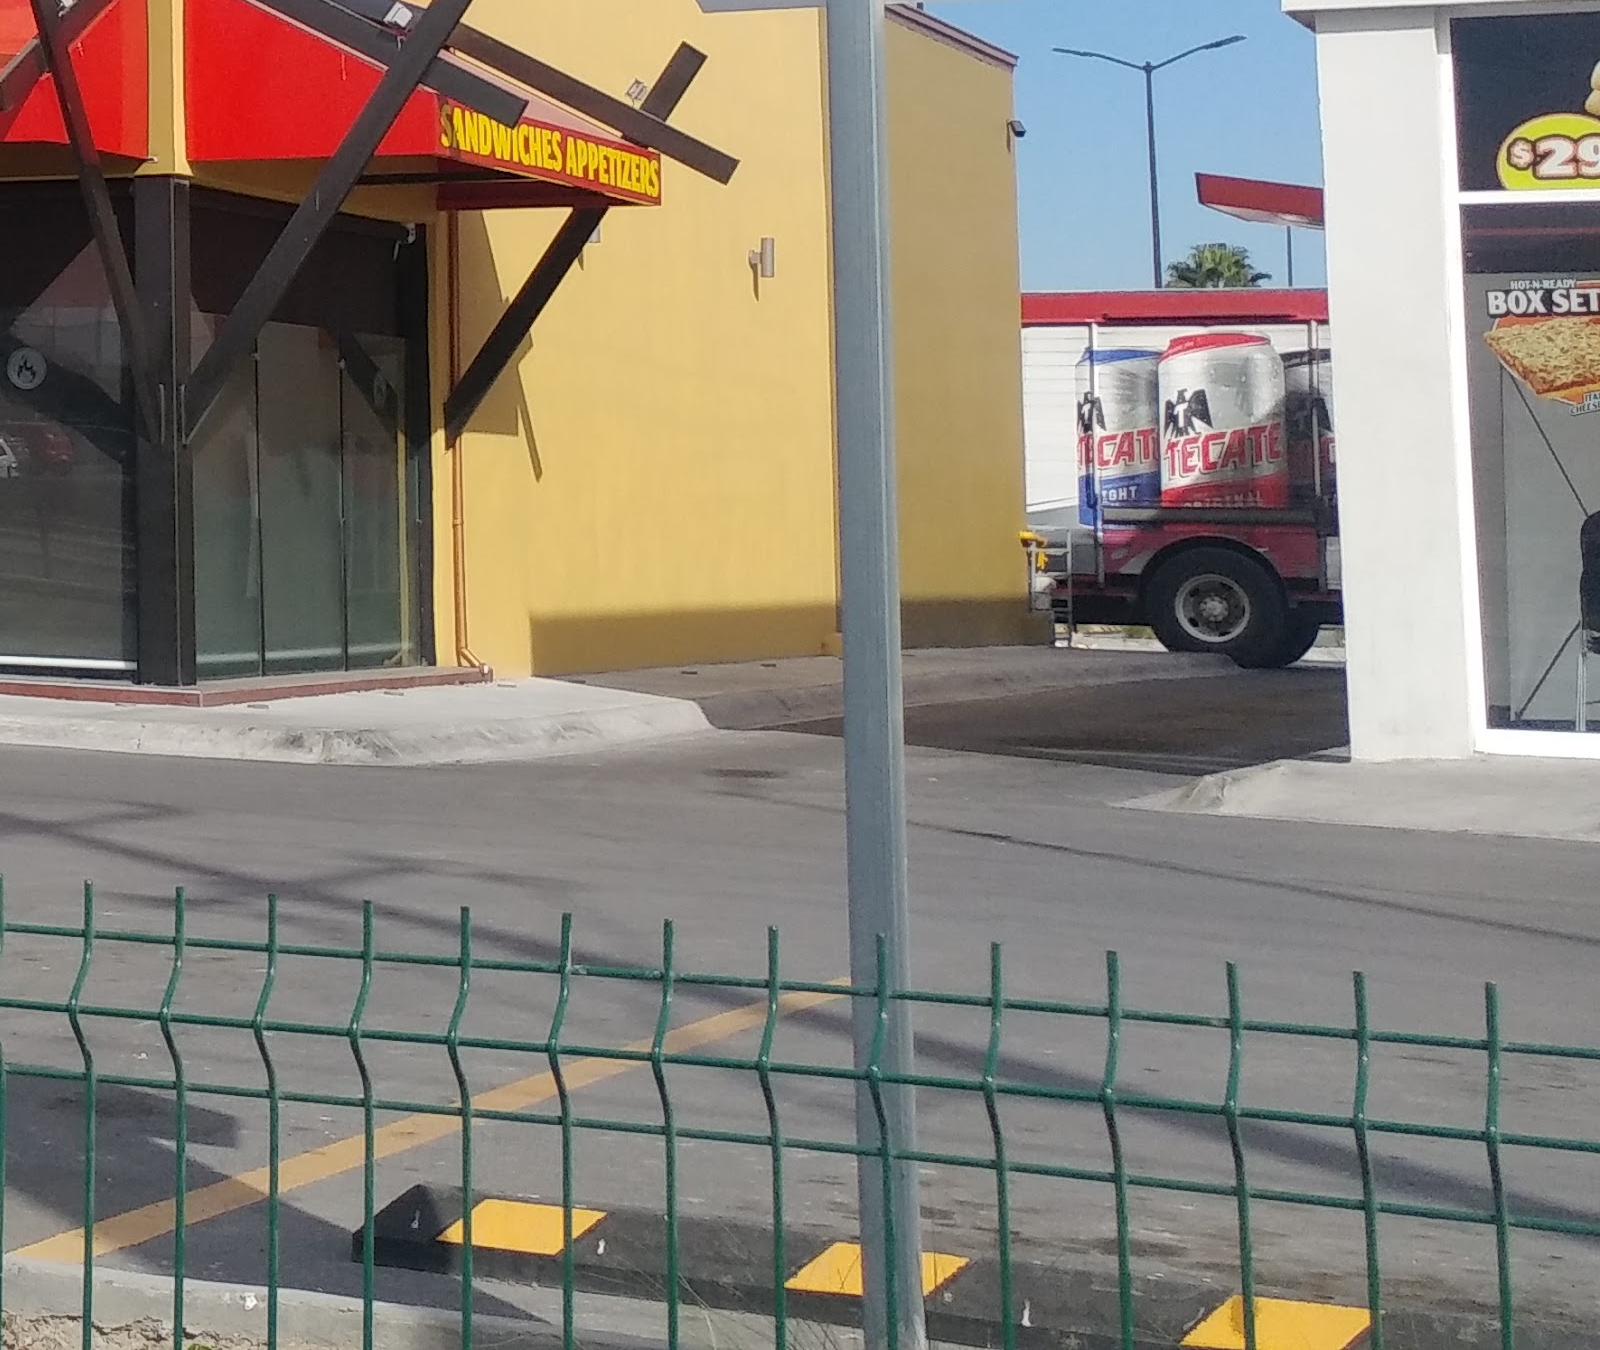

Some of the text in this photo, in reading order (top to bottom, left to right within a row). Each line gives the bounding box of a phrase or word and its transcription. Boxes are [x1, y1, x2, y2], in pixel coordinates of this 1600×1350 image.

[440, 102, 660, 199] SANDWICHES APPETIZERS
[1487, 289, 1548, 315] BOX
[1164, 422, 1282, 478] TECATE
[1101, 486, 1138, 501] IGHT
